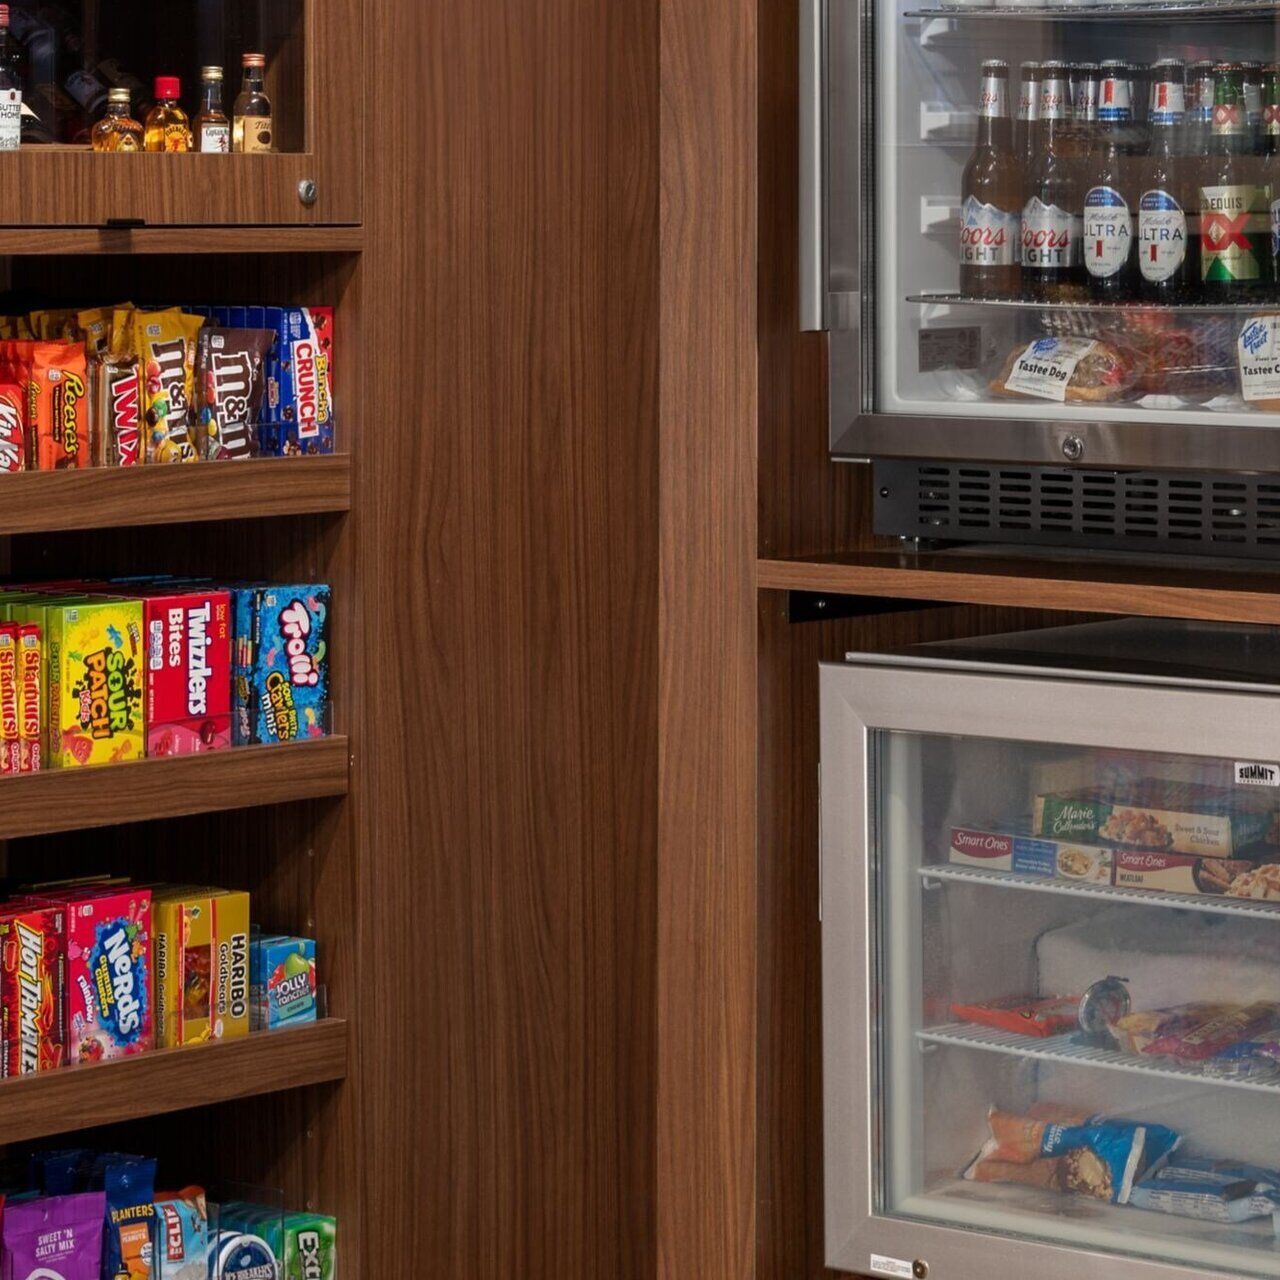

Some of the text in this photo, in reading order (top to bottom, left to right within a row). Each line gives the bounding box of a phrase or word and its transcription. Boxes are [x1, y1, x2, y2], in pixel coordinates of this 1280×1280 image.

[1211, 198, 1243, 210] EQUIS
[961, 247, 999, 262] IGHT
[296, 342, 317, 434] CRUNCH
[1019, 360, 1067, 381] Tastee Dog
[1243, 366, 1272, 376] Tastee
[61, 371, 84, 455] Reese's
[168, 608, 184, 667] Bites
[188, 601, 212, 715] Twizzlers
[282, 602, 318, 686] Trolli
[86, 651, 112, 738] PATCH
[107, 650, 127, 731] SOUR
[266, 672, 289, 739] Crawlers
[261, 693, 277, 735] minis
[1239, 765, 1275, 780] SUMMIT
[1053, 820, 1096, 834] Callender's
[1055, 806, 1094, 820] Marie
[955, 832, 1008, 851] Smart Ones
[1121, 853, 1166, 867] Smart Ones
[158, 933, 166, 979] HARIBO
[231, 934, 246, 1018] HARIBO
[18, 924, 43, 1075] HOT TAMALE
[77, 975, 94, 1024] rainbow
[219, 943, 229, 1014] Goldbears
[277, 973, 306, 998] JOLLY
[279, 985, 310, 1006] rancher
[111, 1204, 154, 1223] PLANTERS
[163, 1206, 182, 1248] CLIF
[35, 1239, 75, 1258] SALTY MIX
[38, 1231, 61, 1246] SWEET
[298, 1231, 321, 1280] EXC
